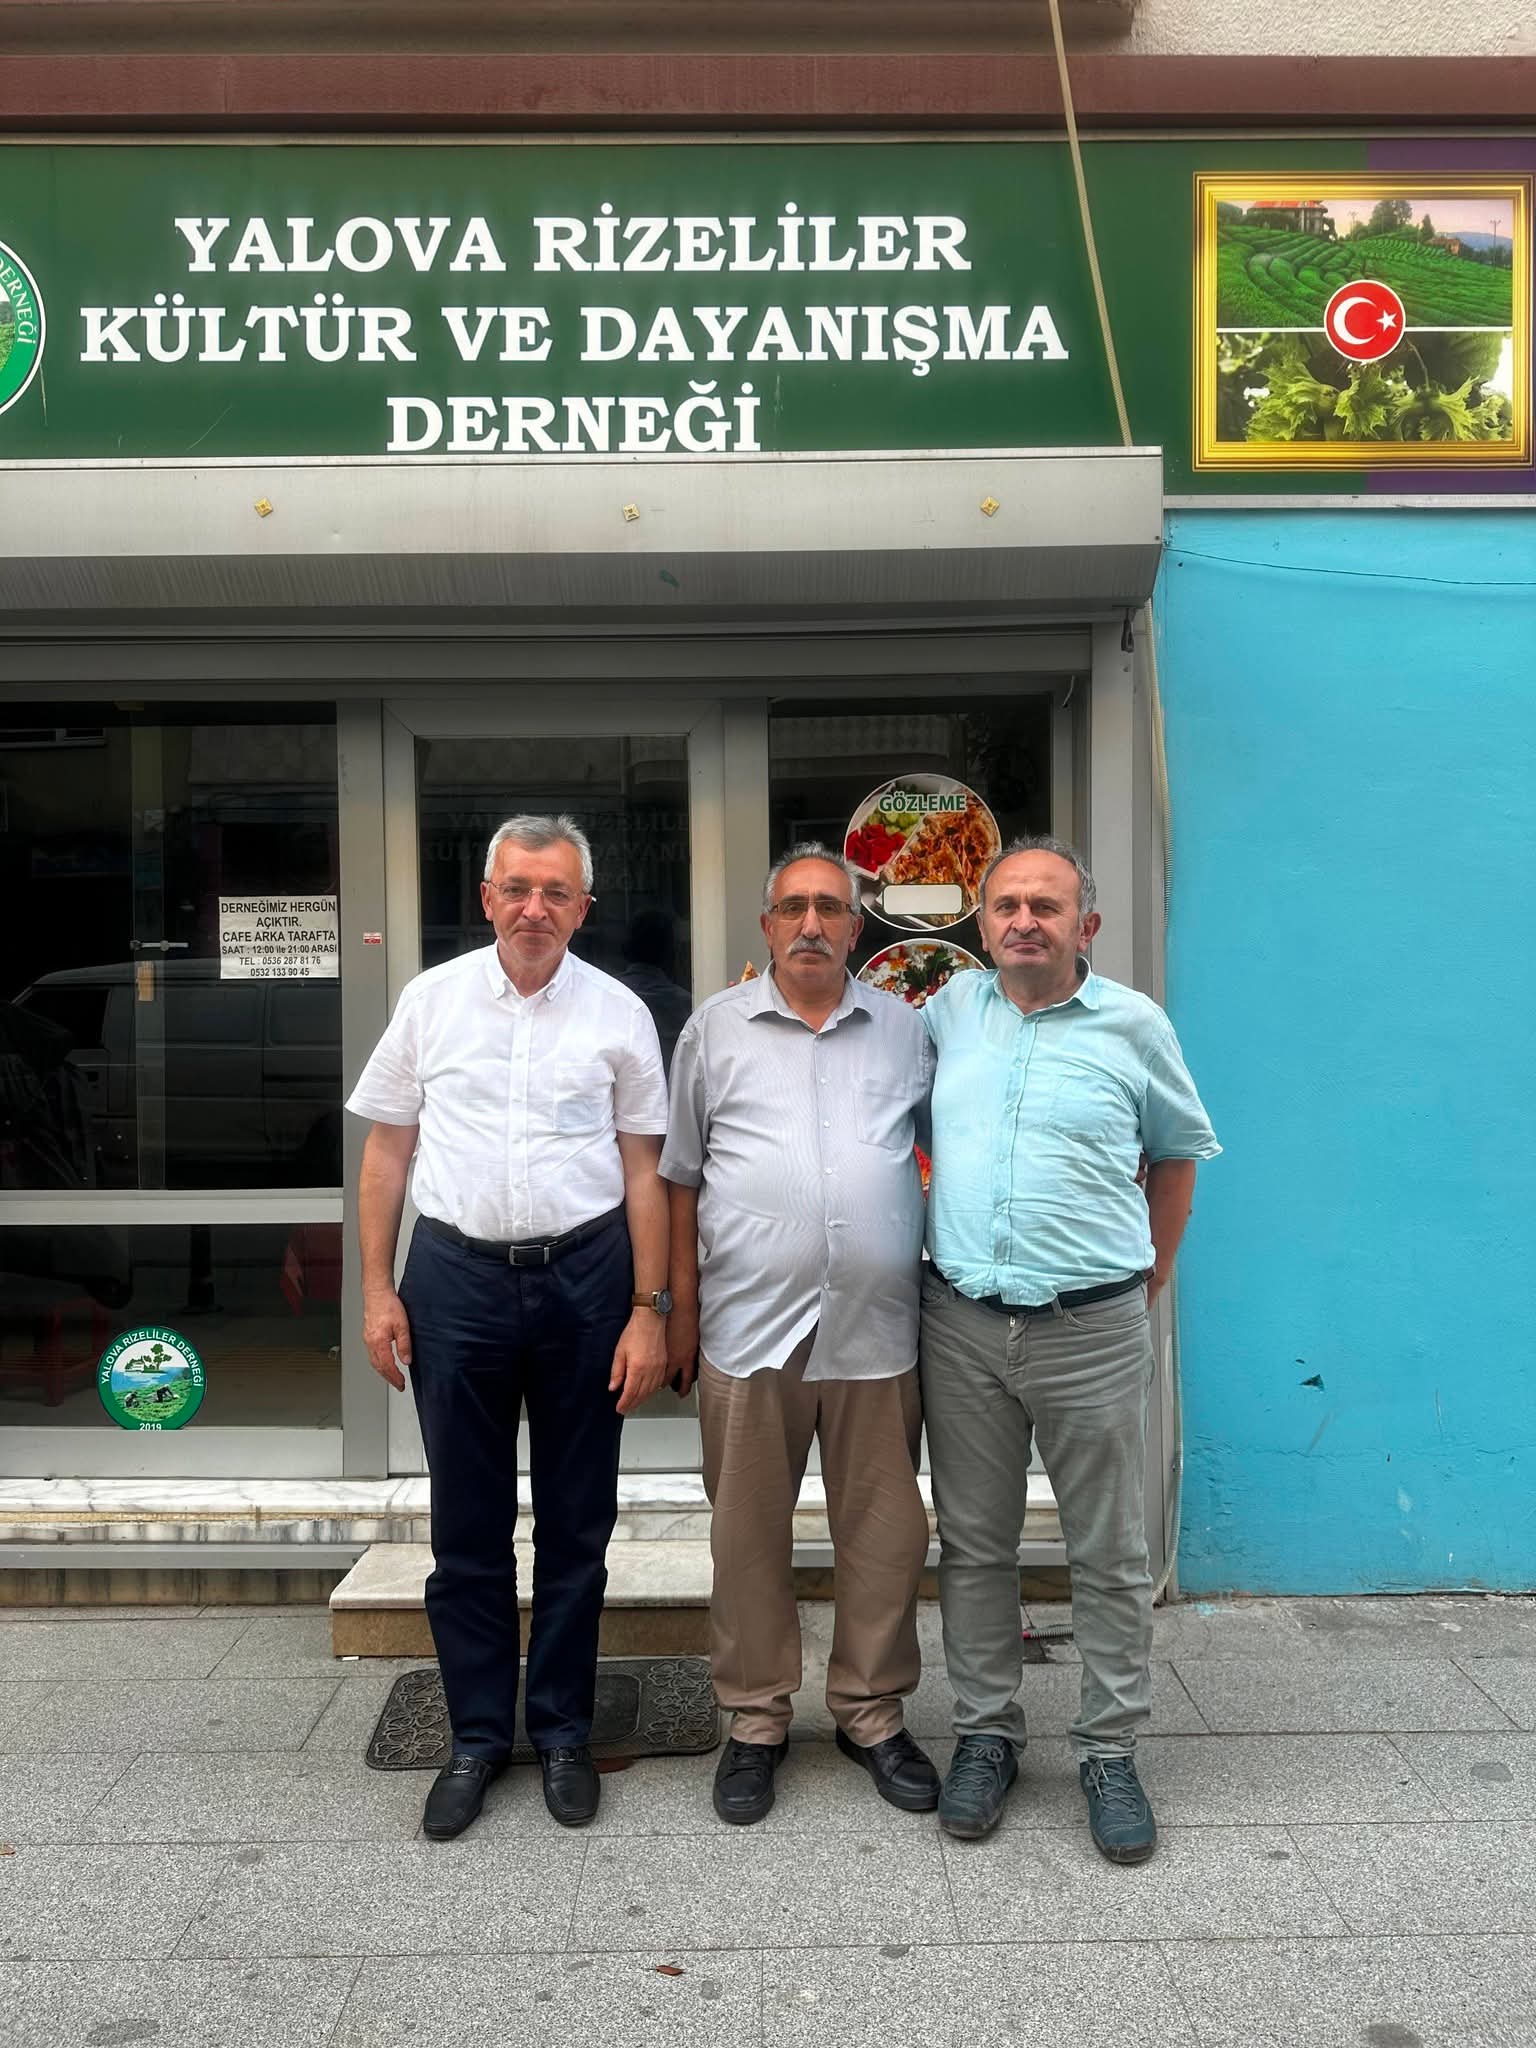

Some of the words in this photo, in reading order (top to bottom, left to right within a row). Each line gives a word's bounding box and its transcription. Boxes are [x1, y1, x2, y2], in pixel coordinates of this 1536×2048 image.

[174, 217, 506, 272] YALOVA
[533, 202, 972, 271] RİZELİLER
[80, 293, 417, 362] KÜLTÜR
[441, 307, 553, 361] VE
[580, 306, 1069, 376] DAYANIŞMA
[386, 380, 761, 452] DERNEĞİ
[879, 791, 966, 812] GÖZLEME
[221, 900, 287, 913] DERNEĞİMİZ
[290, 899, 336, 912] HERGÜN
[256, 916, 302, 929] AÇIKTIR.
[222, 931, 252, 942] CAFE
[254, 931, 285, 942] ARKA
[288, 930, 336, 941] TARAFTA
[222, 945, 244, 954] SAAT
[253, 945, 274, 954] 12:00
[276, 945, 286, 954] ile
[288, 944, 309, 953] 21:00
[311, 944, 337, 953] ARASI
[239, 957, 255, 966] TEL
[262, 956, 281, 965] 0536
[283, 956, 297, 965] 287
[299, 956, 309, 965] 81
[250, 968, 270, 977] 0532
[273, 968, 286, 977] 133
[299, 968, 310, 976] 45
[101, 1343, 124, 1384] YALOVA
[122, 1328, 177, 1346] RİZELİLER
[176, 1341, 204, 1387] DERNEĞİ
[139, 1422, 162, 1431] 2019
